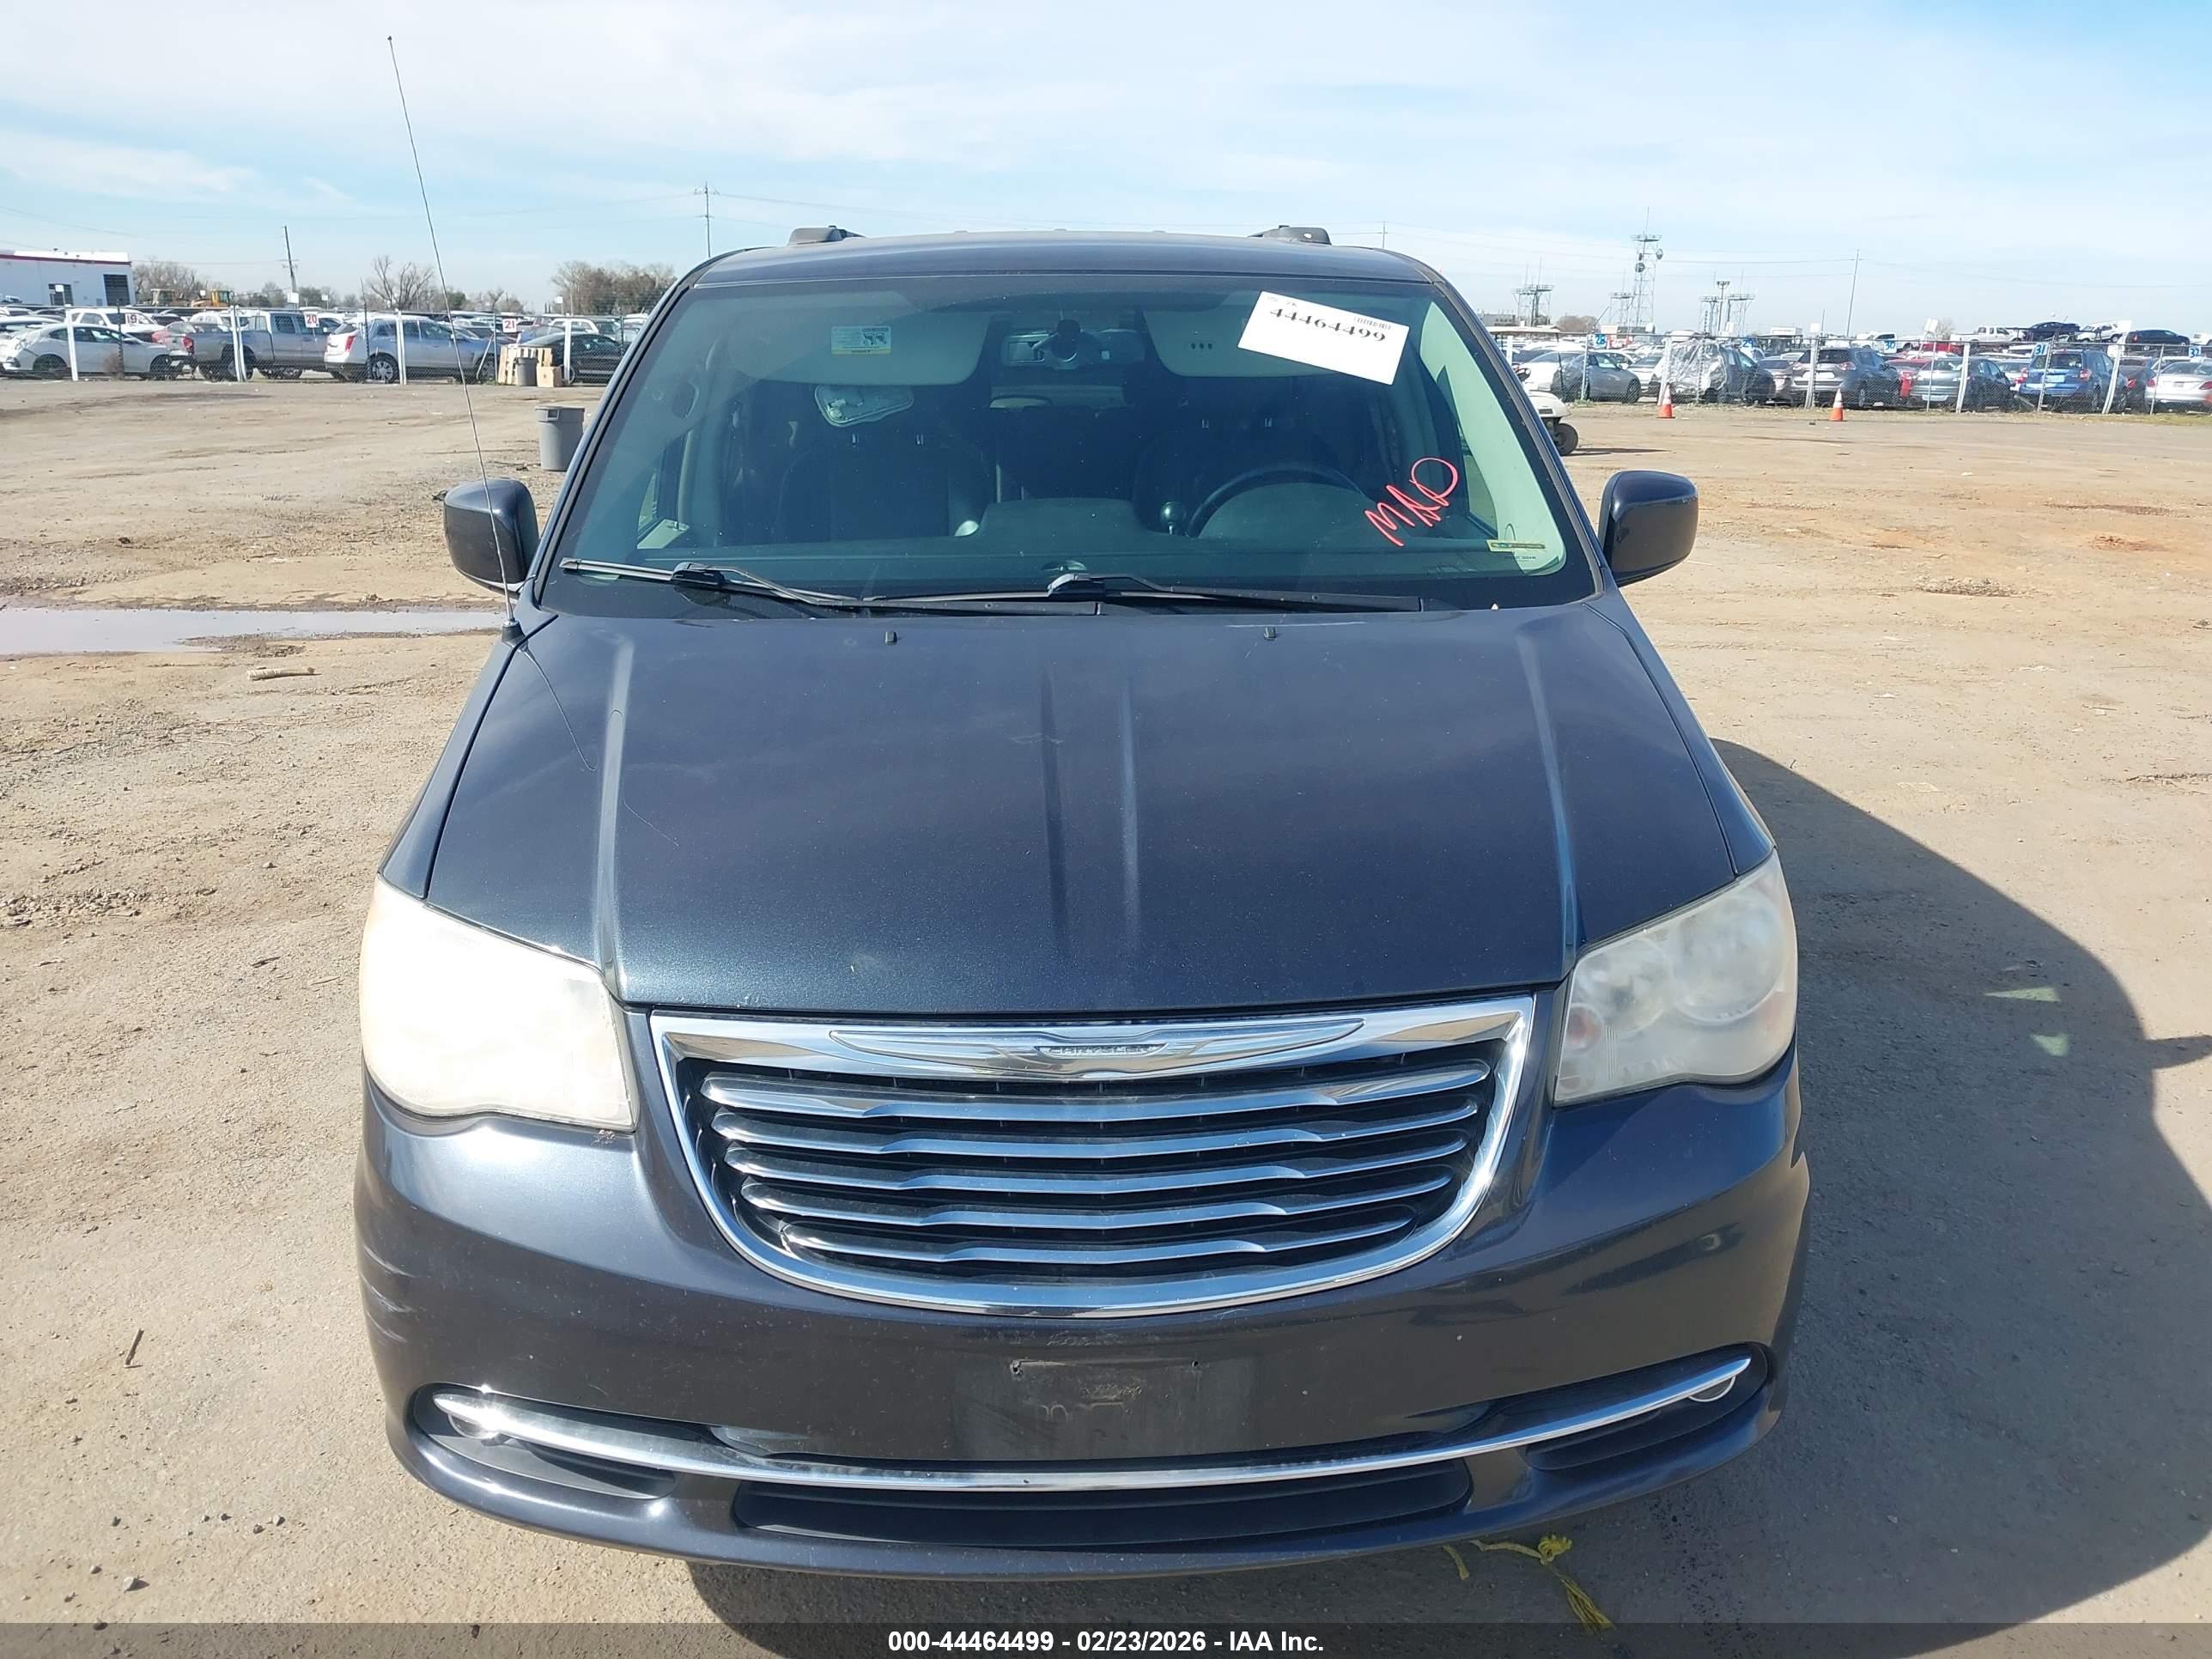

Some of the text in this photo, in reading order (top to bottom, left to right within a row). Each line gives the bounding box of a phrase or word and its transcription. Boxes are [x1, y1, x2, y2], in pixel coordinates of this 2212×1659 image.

[126, 314, 137, 324] 19
[307, 314, 317, 324] 20
[504, 319, 515, 329] 21
[1270, 307, 1386, 343] 44464499
[1885, 340, 1896, 350] 30
[2035, 343, 2046, 355] 31
